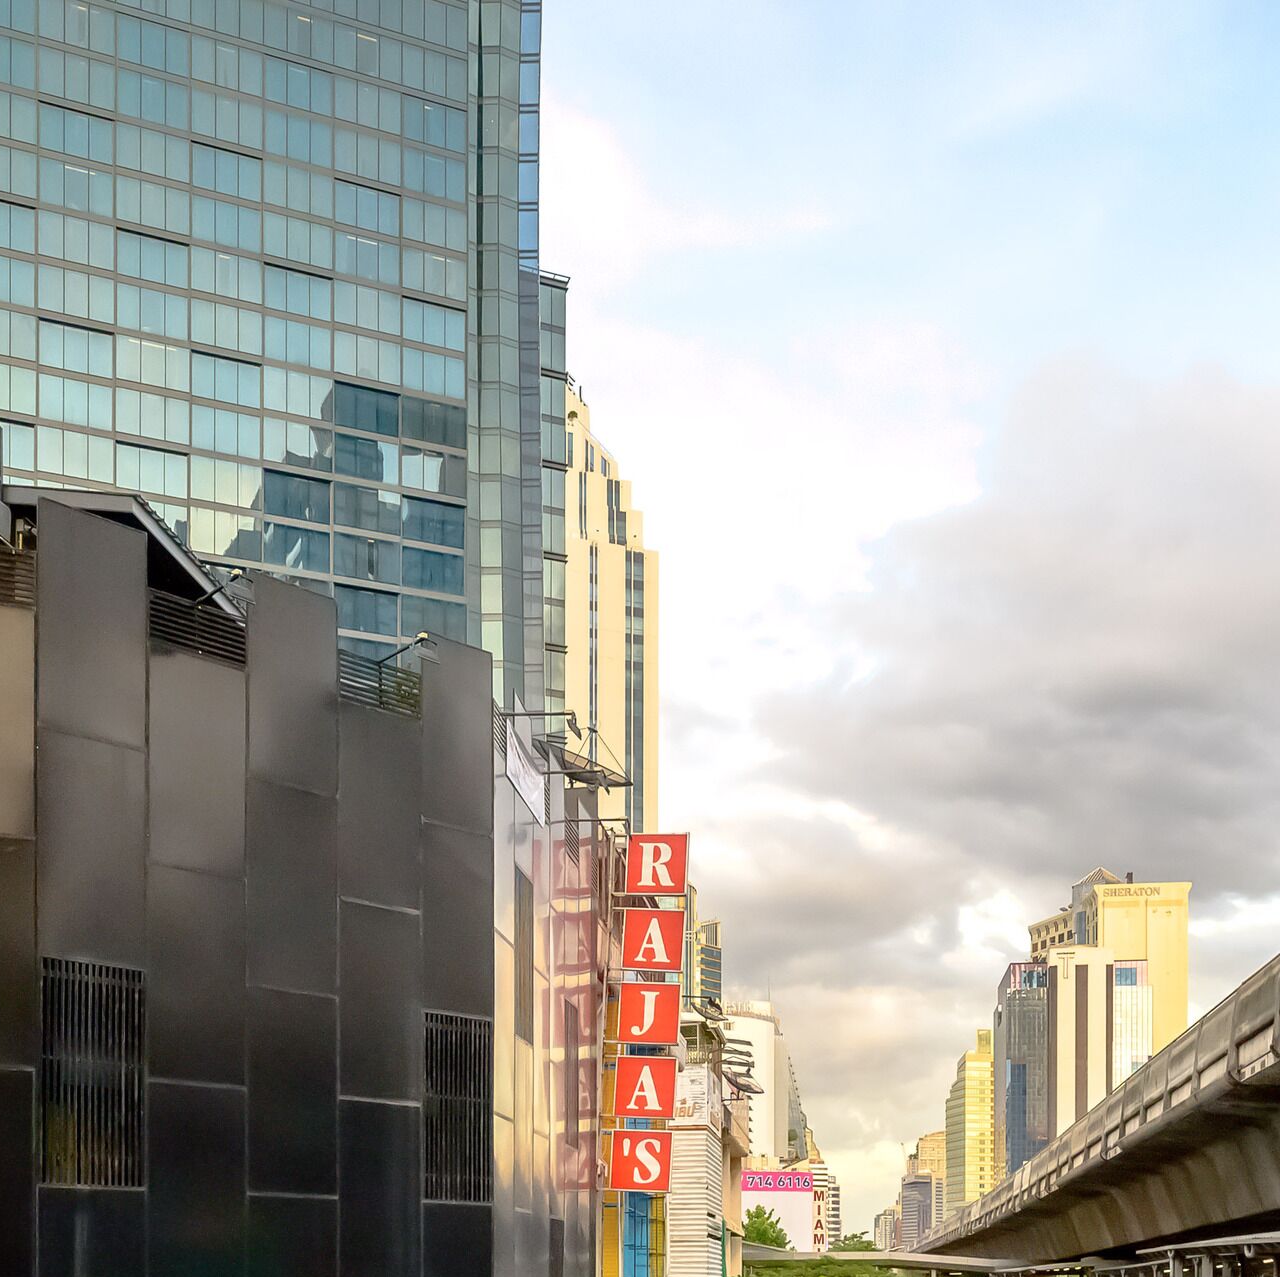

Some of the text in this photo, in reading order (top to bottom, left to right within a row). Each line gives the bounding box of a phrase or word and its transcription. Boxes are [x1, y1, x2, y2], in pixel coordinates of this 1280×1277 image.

[1103, 886, 1161, 898] SHERATON
[746, 1175, 811, 1189] 714 6116
[813, 1190, 825, 1252] MIAM
